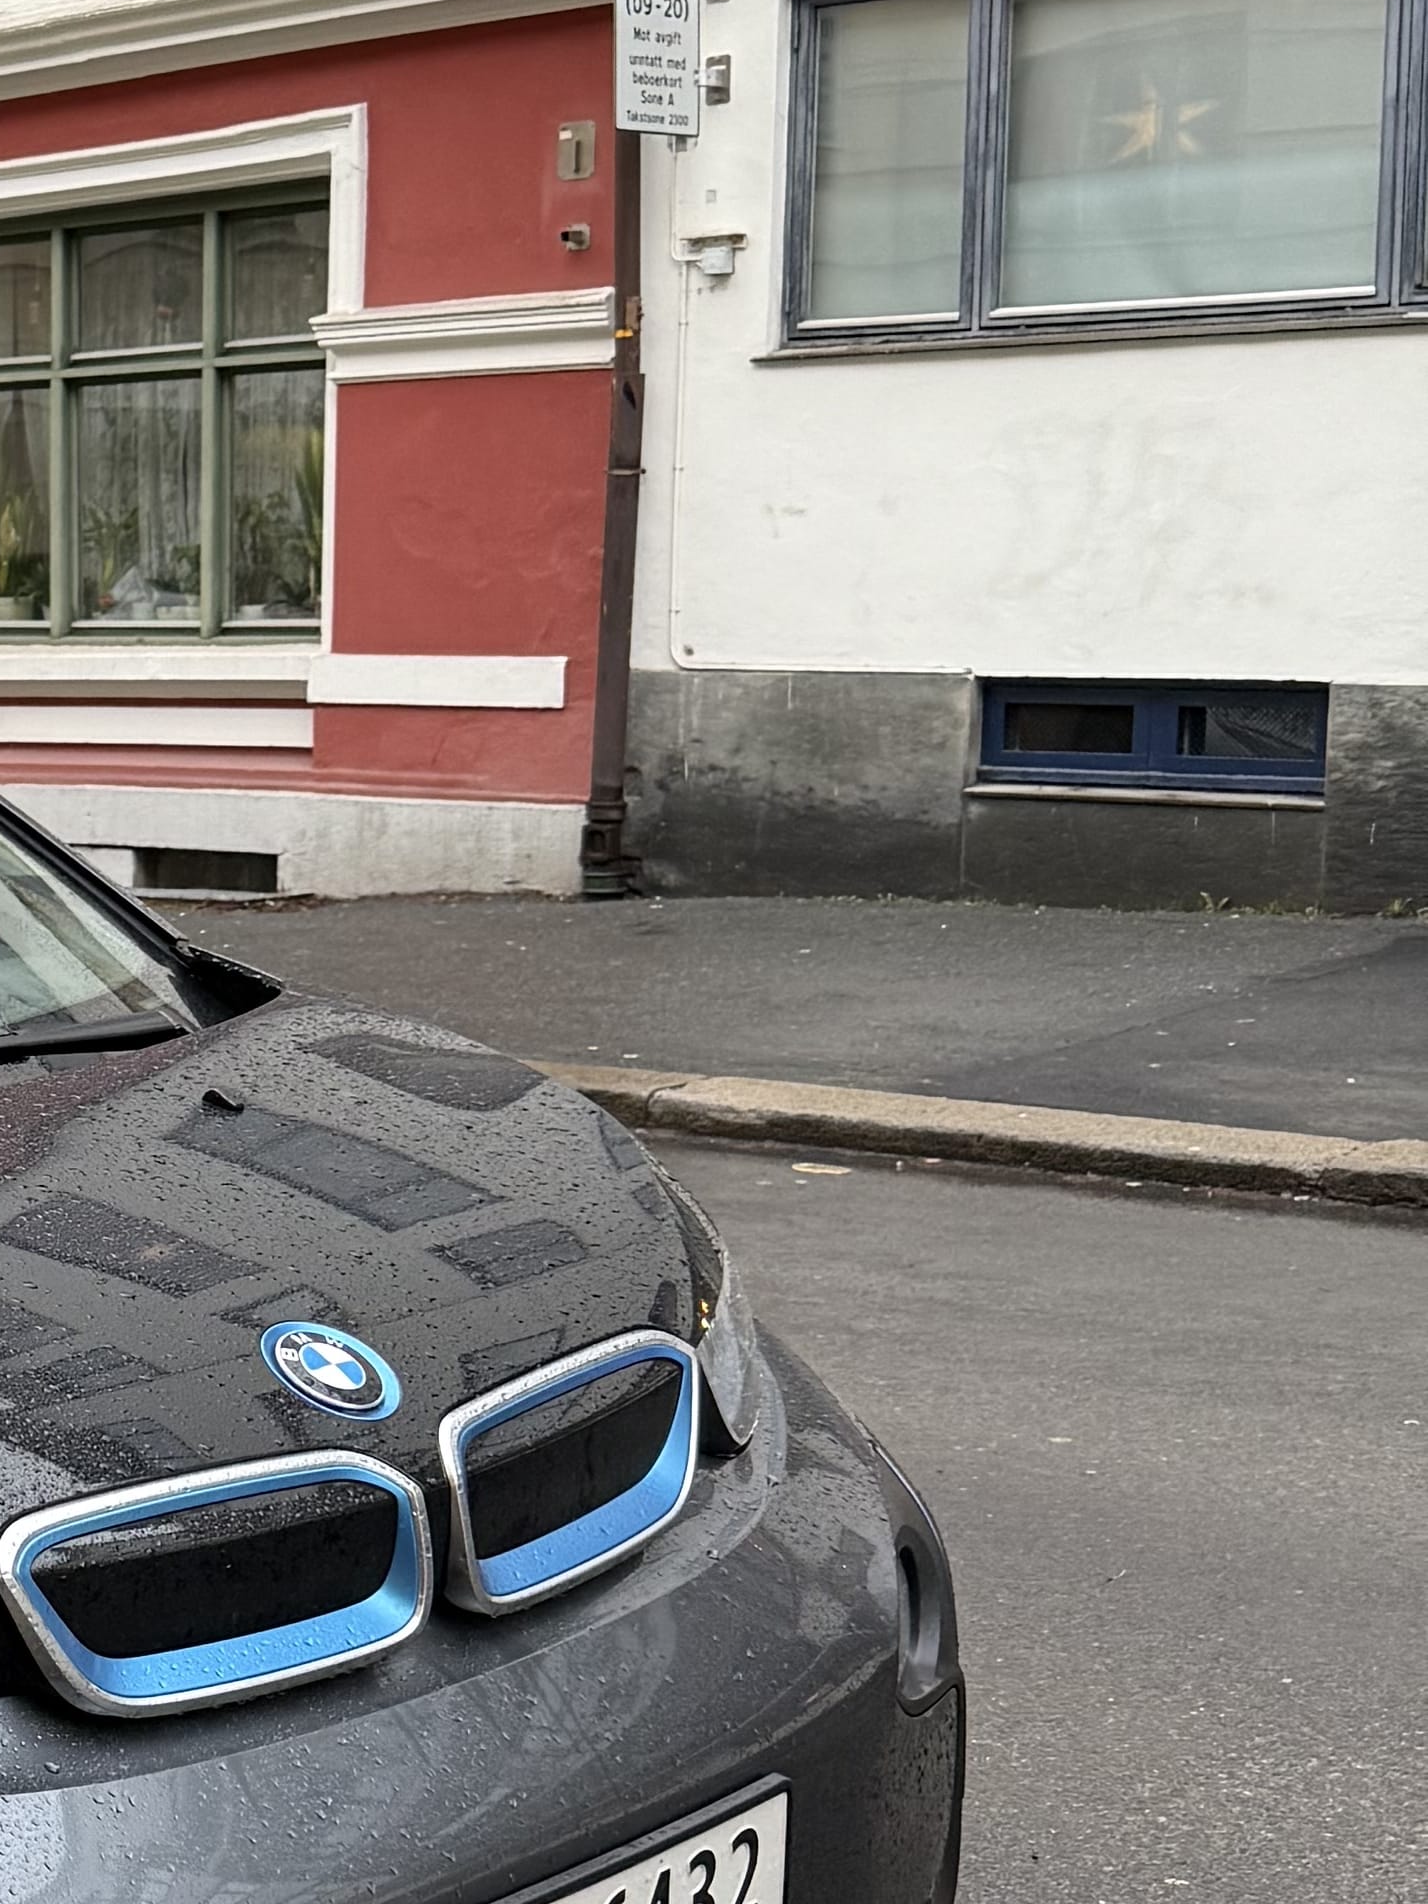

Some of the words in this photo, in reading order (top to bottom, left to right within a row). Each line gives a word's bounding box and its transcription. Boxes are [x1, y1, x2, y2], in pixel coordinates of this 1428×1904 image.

[633, 26, 651, 43] Mot
[655, 31, 682, 47] avgift
[666, 56, 687, 71] med
[632, 71, 683, 89] beboerkort
[640, 89, 663, 106] Sone
[667, 92, 675, 106] A
[280, 1332, 344, 1362] BMW
